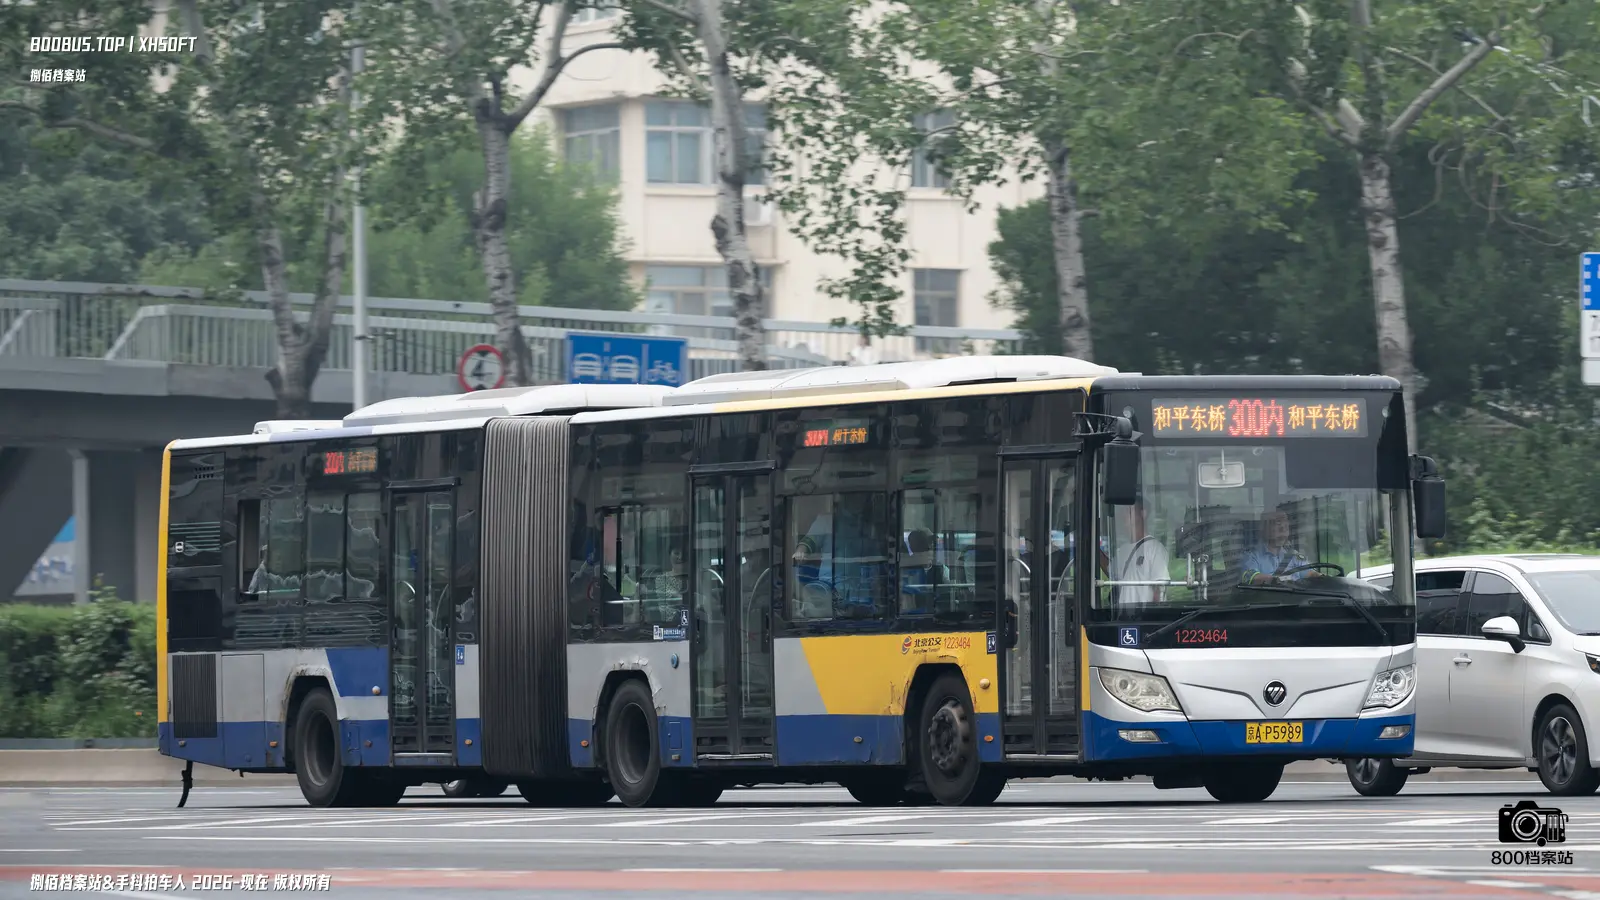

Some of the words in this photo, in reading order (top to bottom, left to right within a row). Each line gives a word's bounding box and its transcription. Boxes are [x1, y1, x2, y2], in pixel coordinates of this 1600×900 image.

[1153, 405, 1226, 431] 和平东桥
[1228, 399, 1285, 436] 300内
[1288, 404, 1360, 430] 和平东桥
[1175, 629, 1228, 643] 1223464
[914, 637, 942, 648] 北京公交
[944, 637, 971, 650] 1223464
